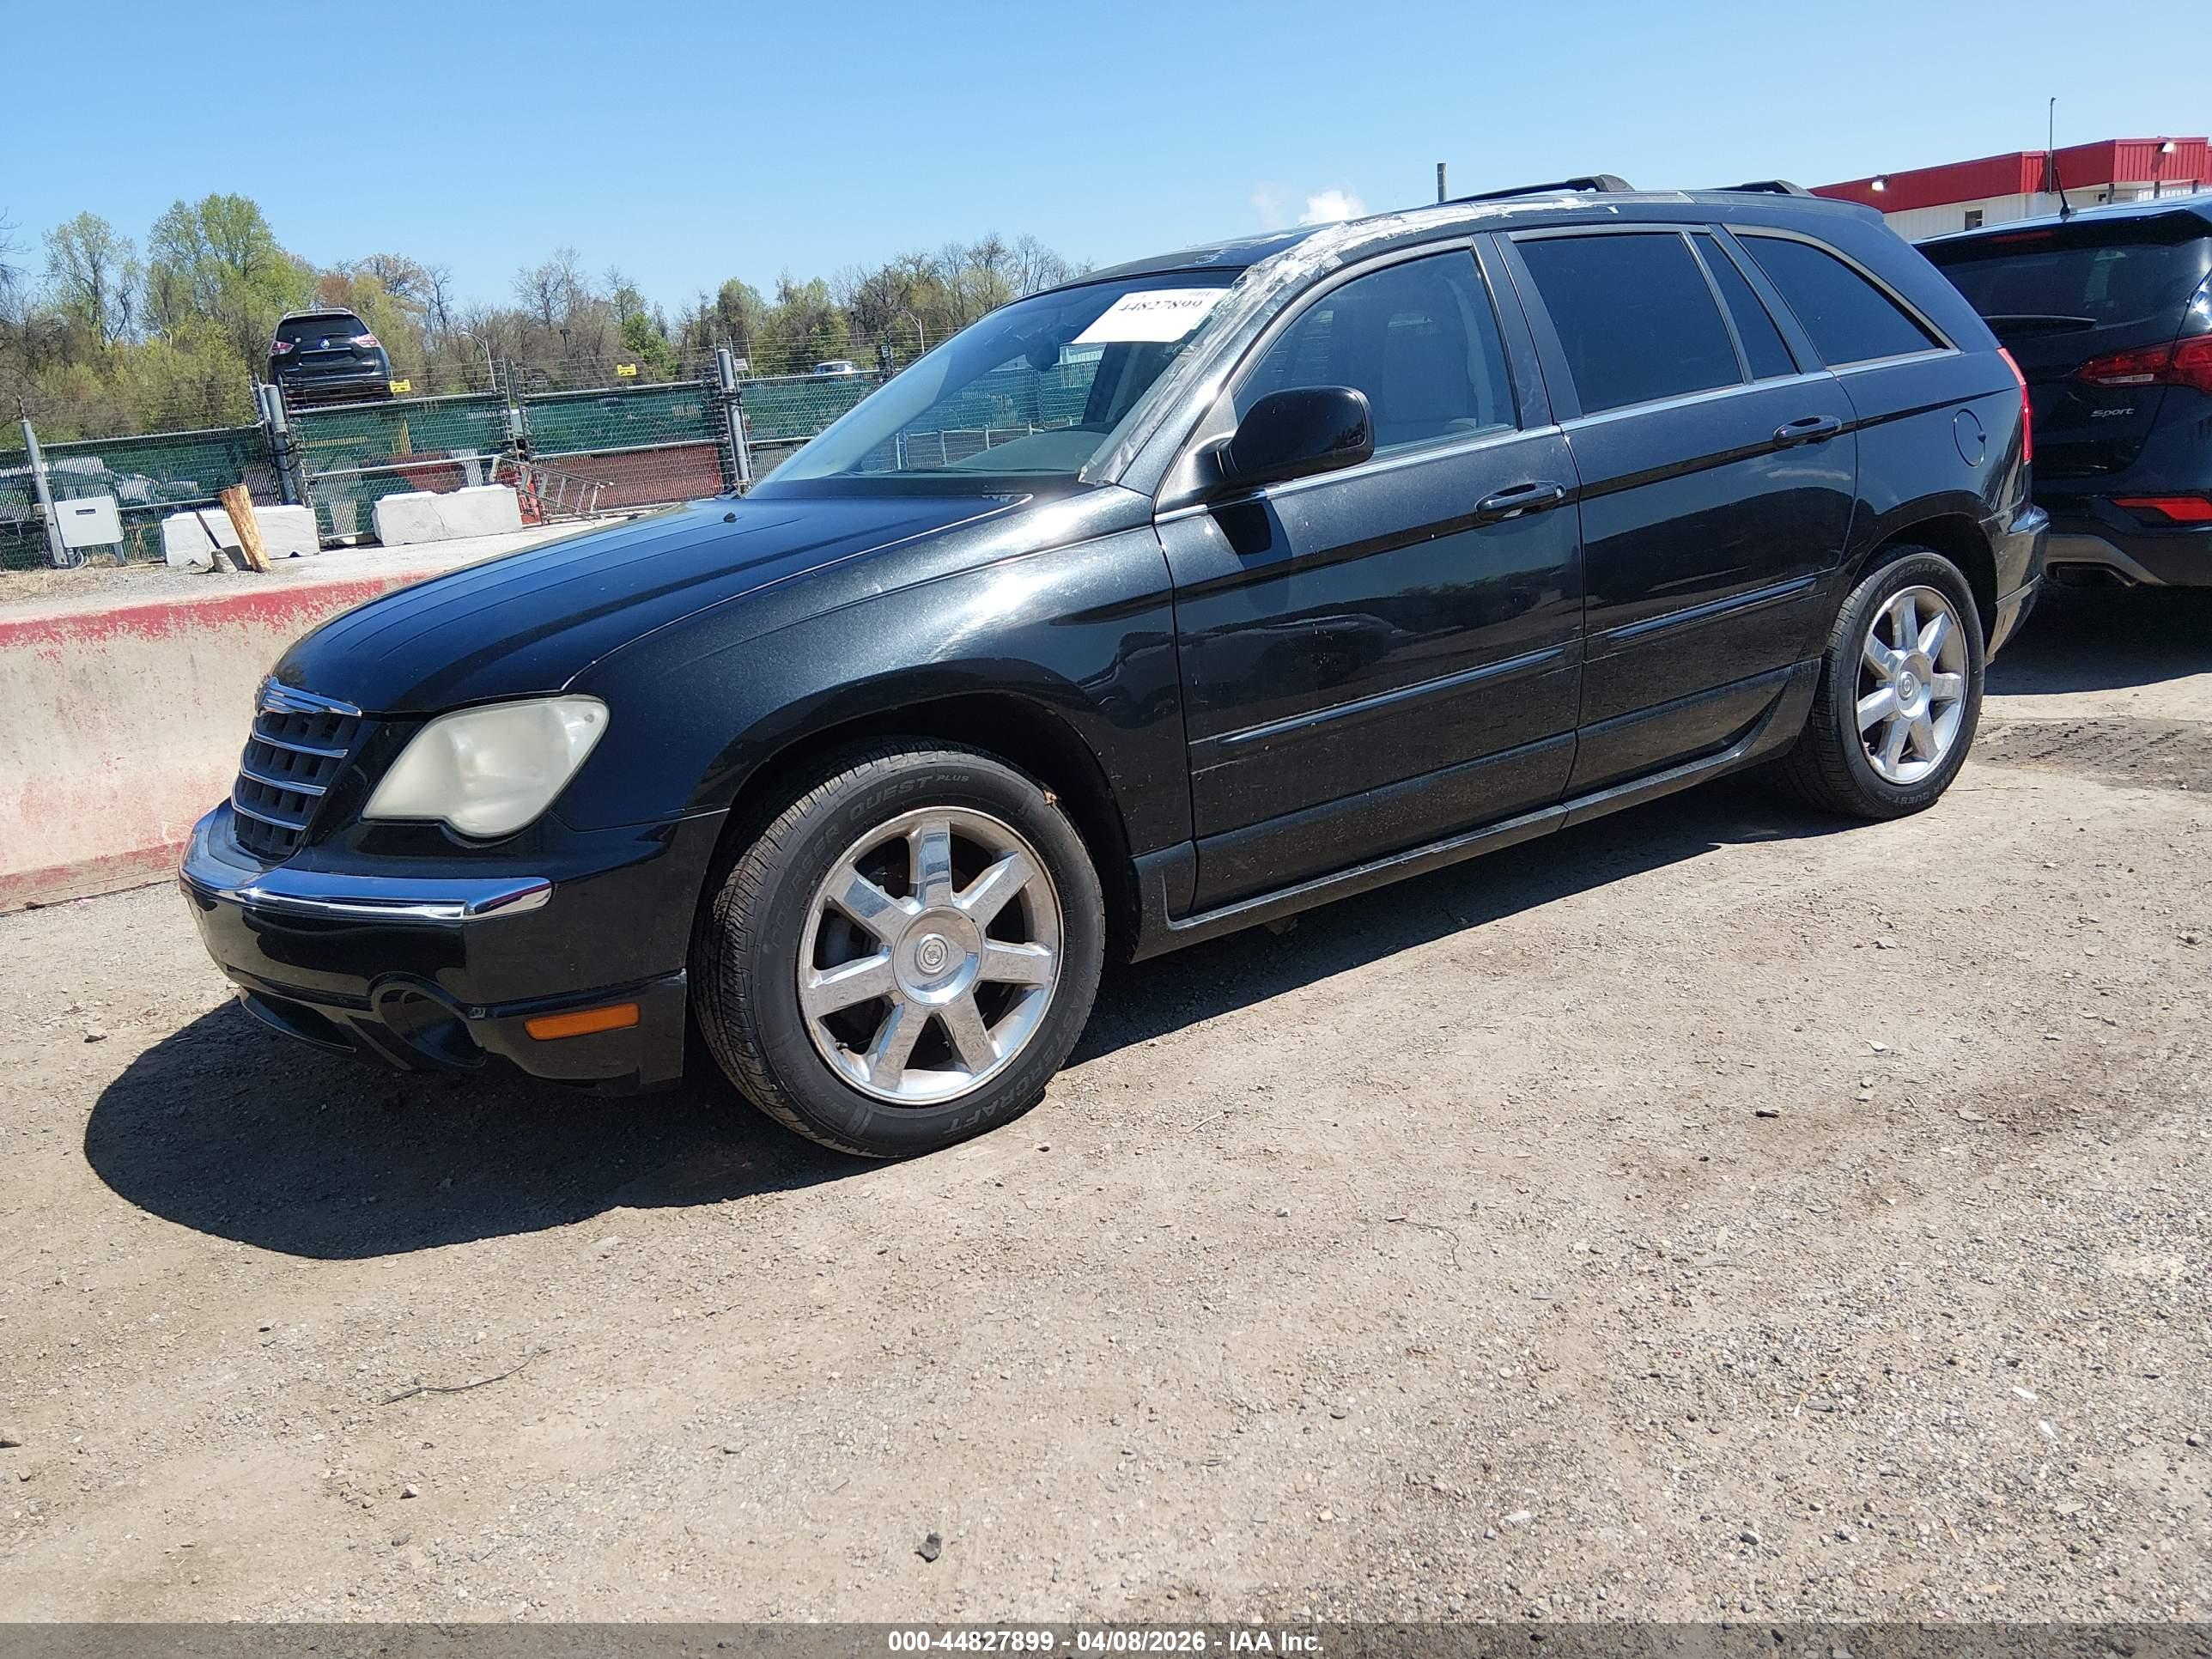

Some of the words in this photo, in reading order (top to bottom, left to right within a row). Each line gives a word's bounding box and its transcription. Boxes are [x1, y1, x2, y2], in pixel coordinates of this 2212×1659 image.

[1117, 299, 1203, 311] 44827899
[2089, 407, 2136, 418] Sport
[848, 775, 934, 822] QUEST
[936, 774, 970, 784] PLUS
